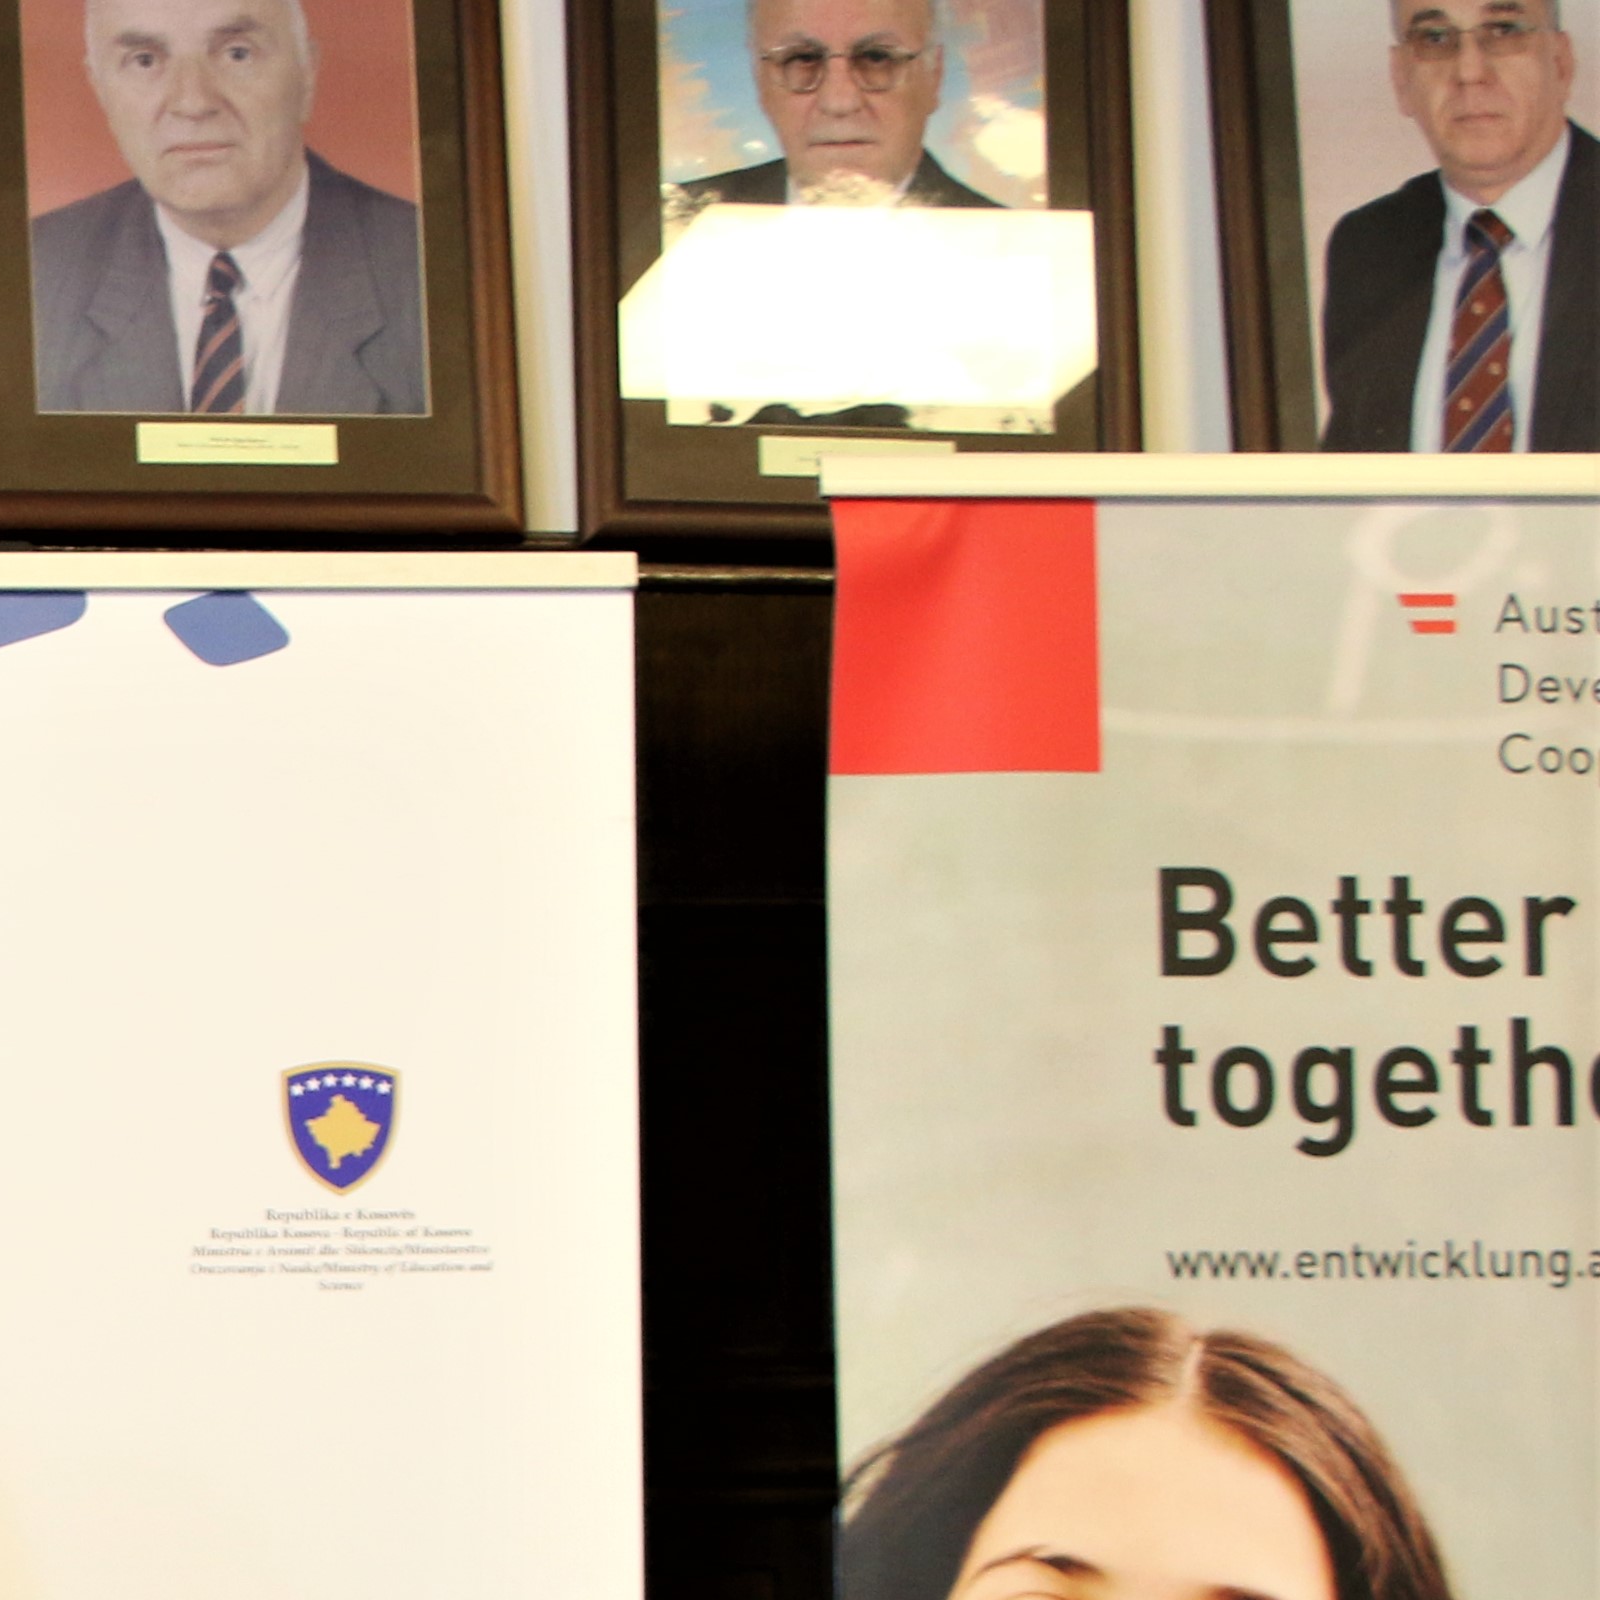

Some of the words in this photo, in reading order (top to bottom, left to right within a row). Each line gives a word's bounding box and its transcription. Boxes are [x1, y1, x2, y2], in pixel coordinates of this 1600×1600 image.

[1498, 732, 1600, 776] Coo
[1156, 866, 1577, 979] Better
[1153, 1017, 1600, 1158] togeth
